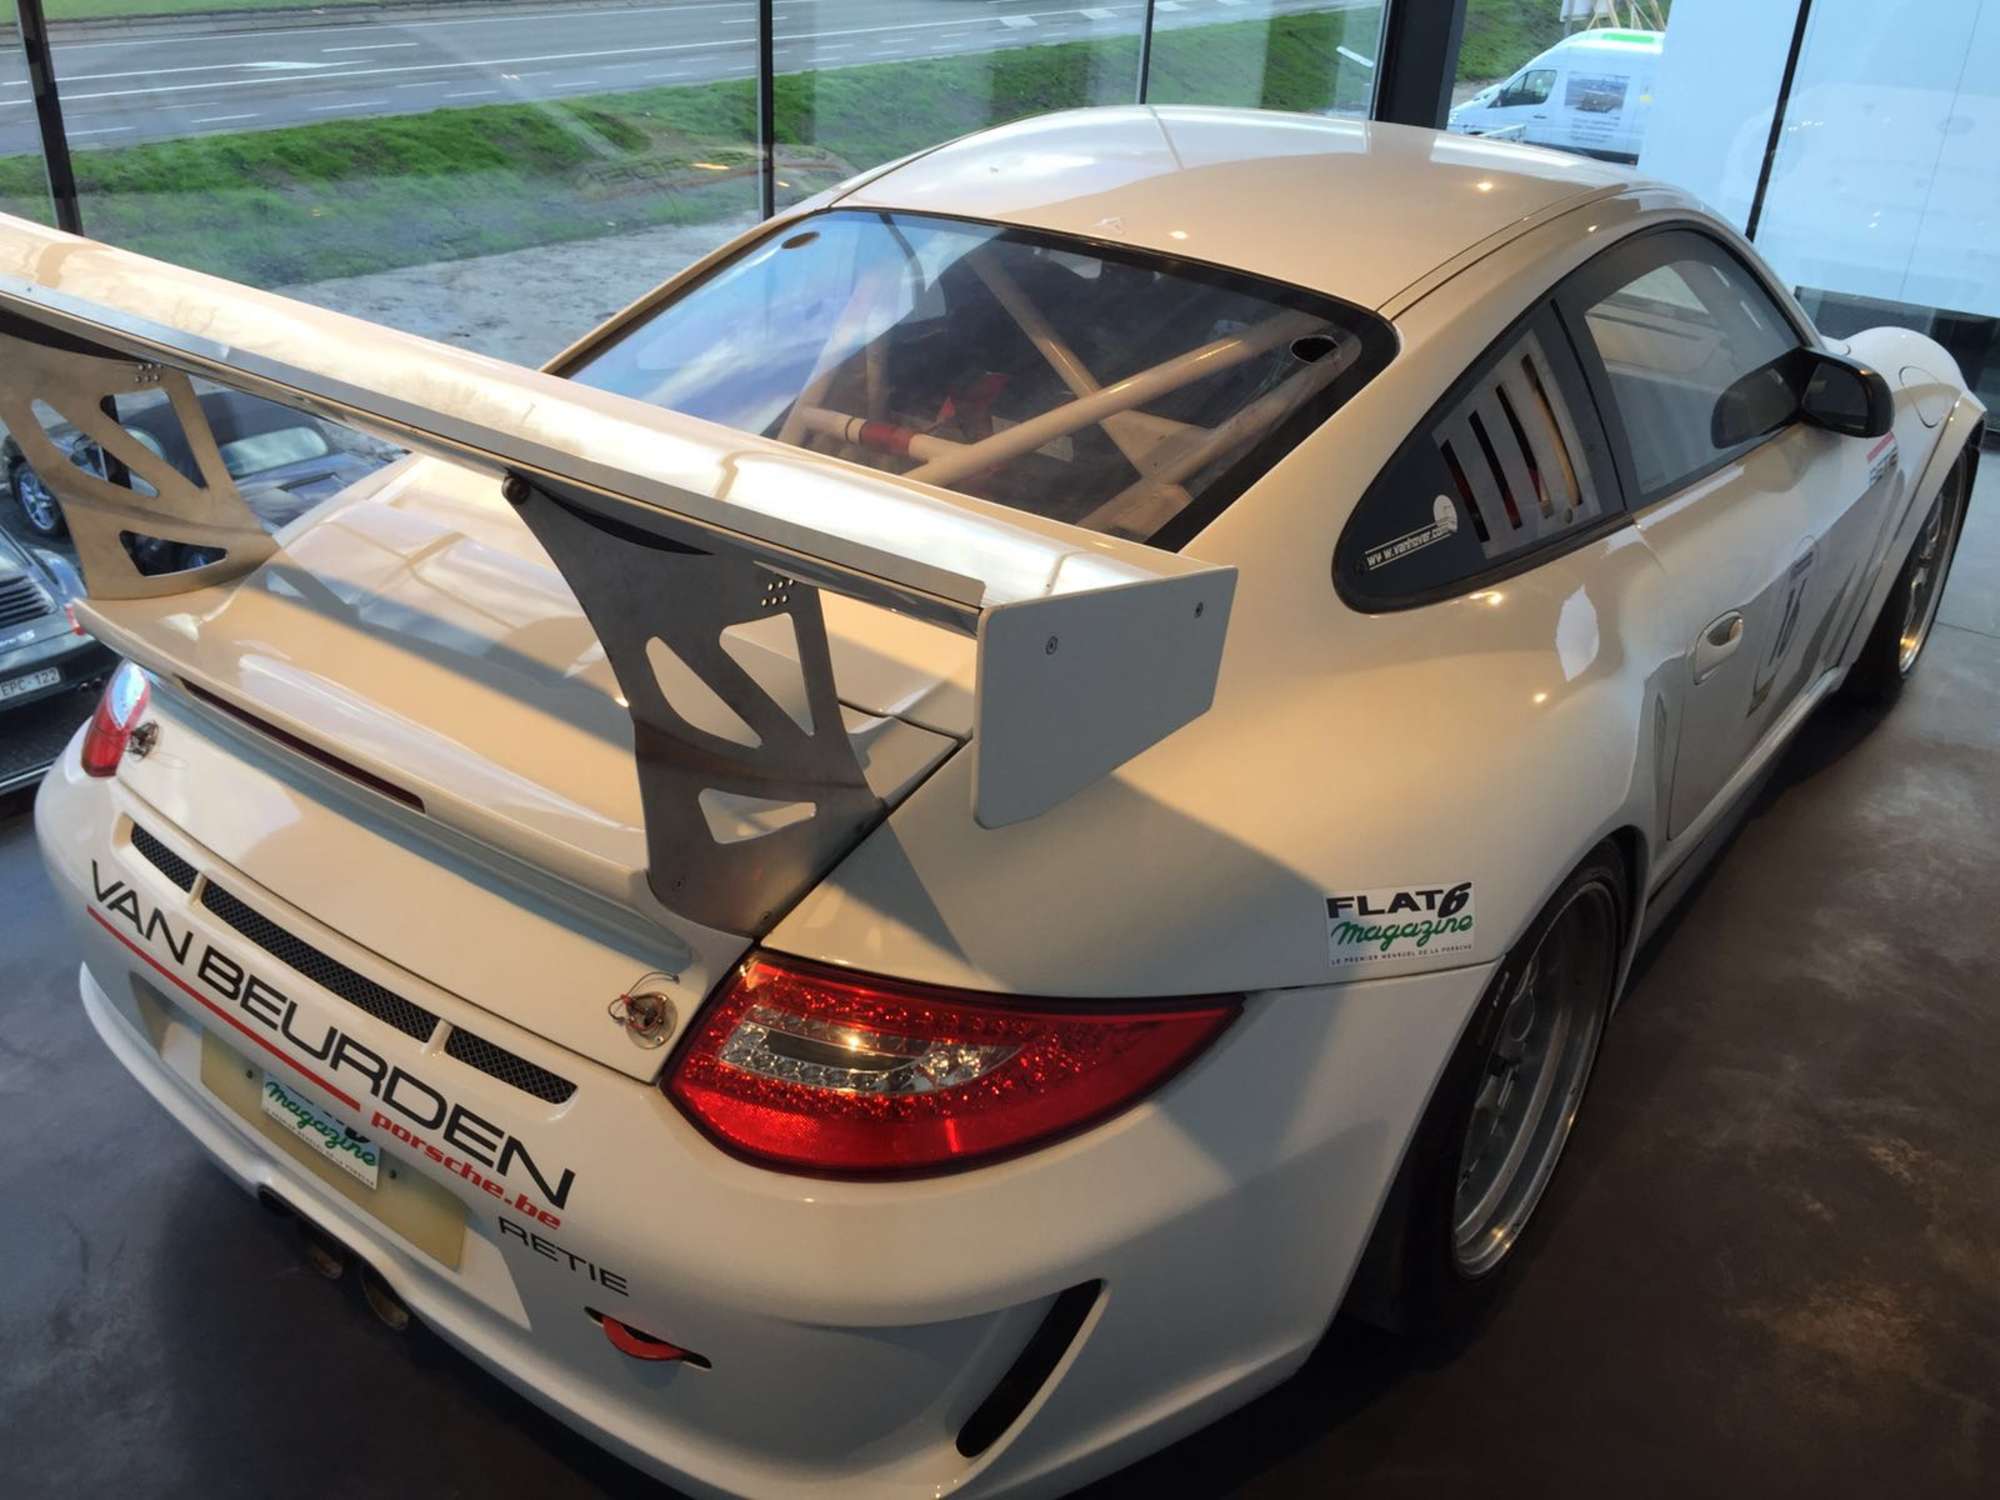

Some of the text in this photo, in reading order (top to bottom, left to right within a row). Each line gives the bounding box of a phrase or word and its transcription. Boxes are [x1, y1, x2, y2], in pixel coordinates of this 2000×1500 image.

[92, 859, 194, 966] VAN
[197, 945, 576, 1210] BEURDEN
[370, 1111, 561, 1230] porsche.be
[498, 1216, 630, 1297] RETIE
